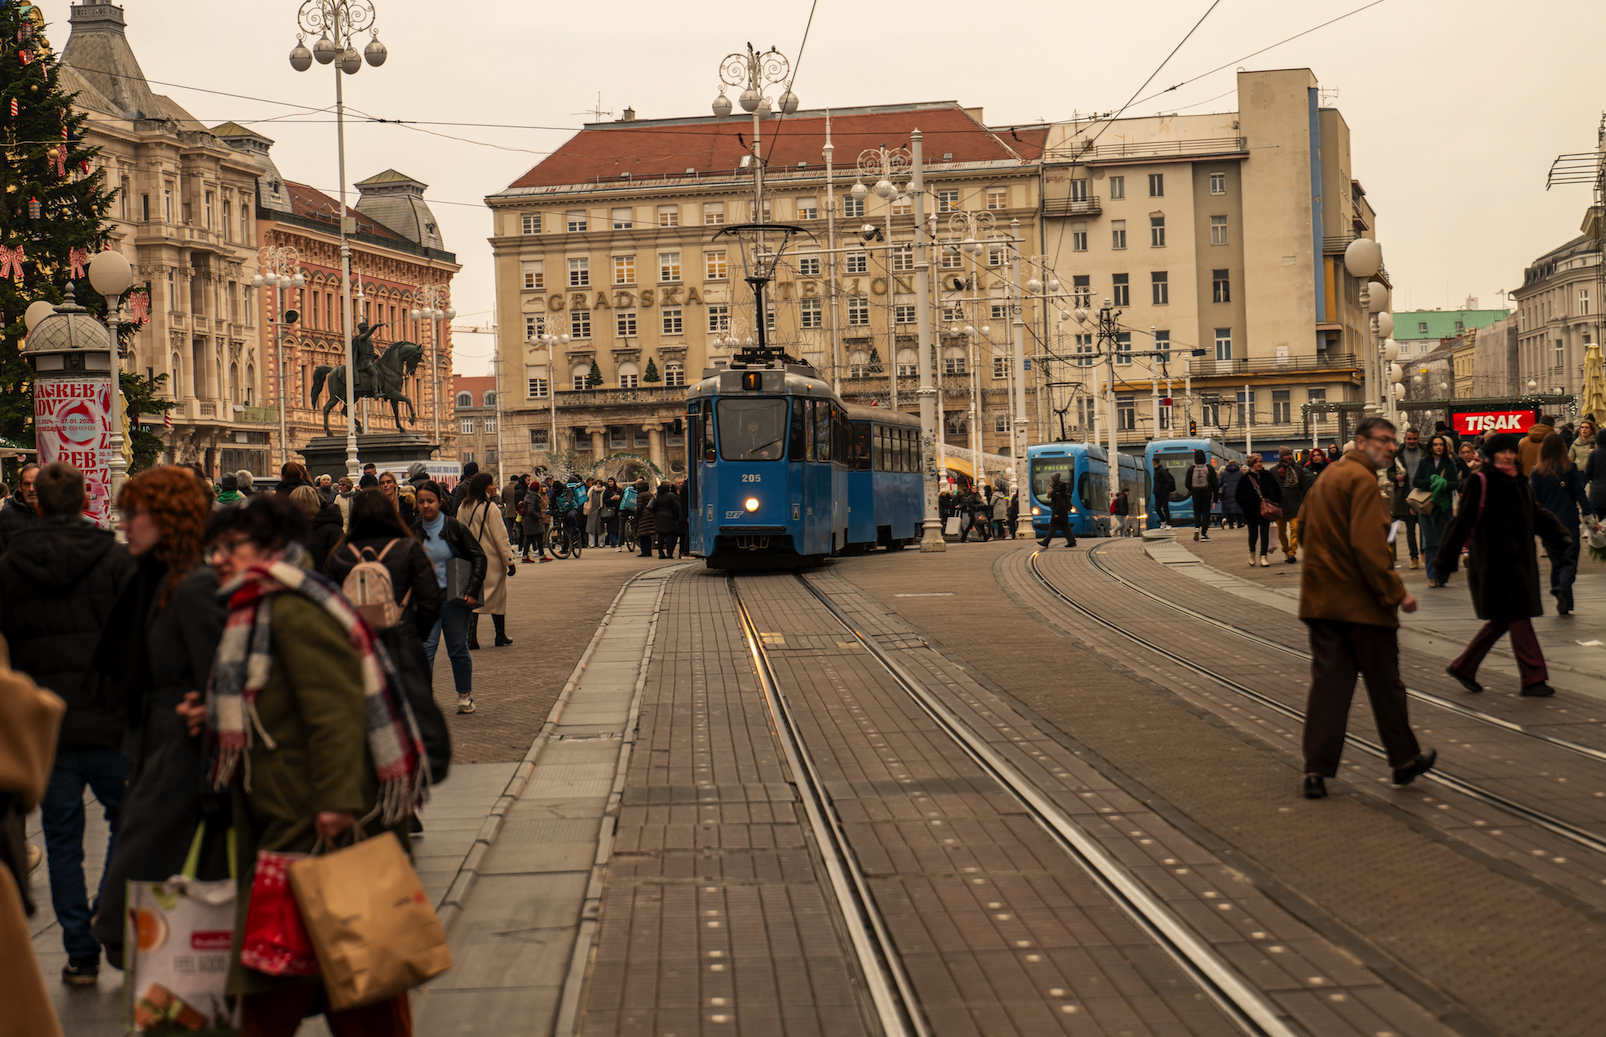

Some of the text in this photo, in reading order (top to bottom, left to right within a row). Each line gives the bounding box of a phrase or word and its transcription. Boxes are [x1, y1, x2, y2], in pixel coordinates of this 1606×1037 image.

[547, 287, 704, 312] GRADSKA
[748, 373, 755, 388] 1
[1465, 414, 1522, 431] TISAK
[742, 474, 761, 482] 205
[725, 510, 744, 519] ZET
